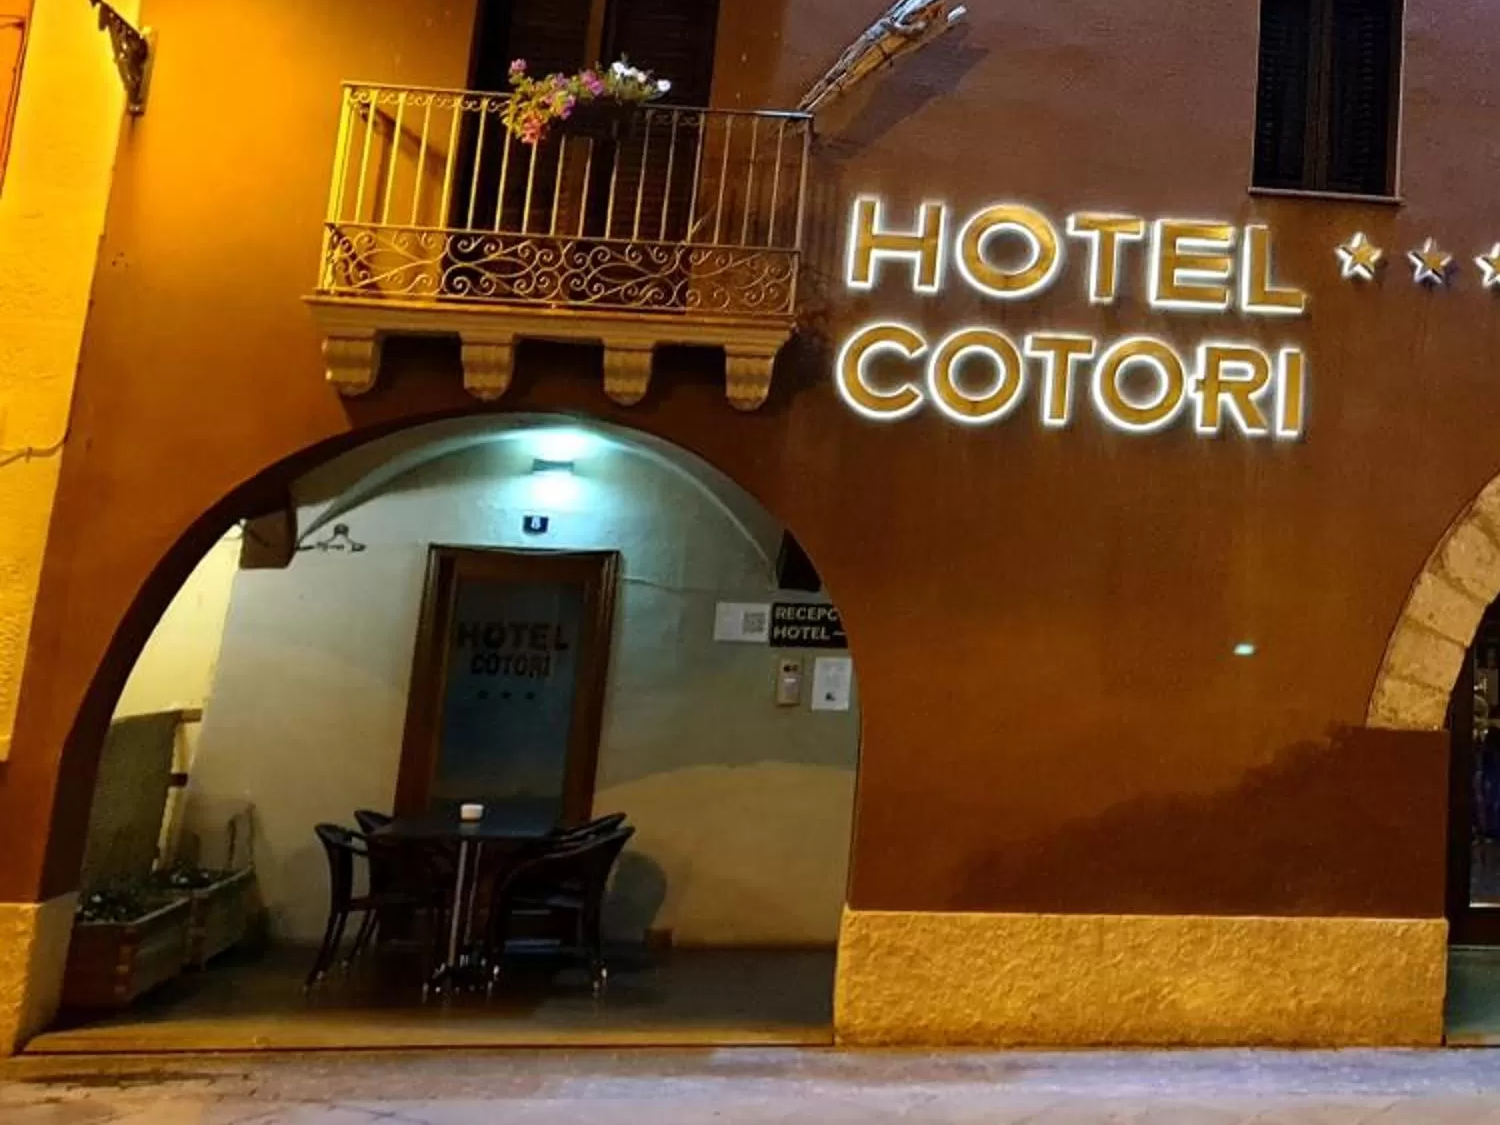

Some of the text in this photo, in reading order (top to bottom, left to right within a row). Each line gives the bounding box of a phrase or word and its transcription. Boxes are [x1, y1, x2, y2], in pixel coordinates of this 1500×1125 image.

[847, 196, 1306, 313] HOTEL
[837, 321, 1304, 437] COTORI
[457, 623, 569, 651] HOTEL
[773, 626, 830, 640] HOTEL
